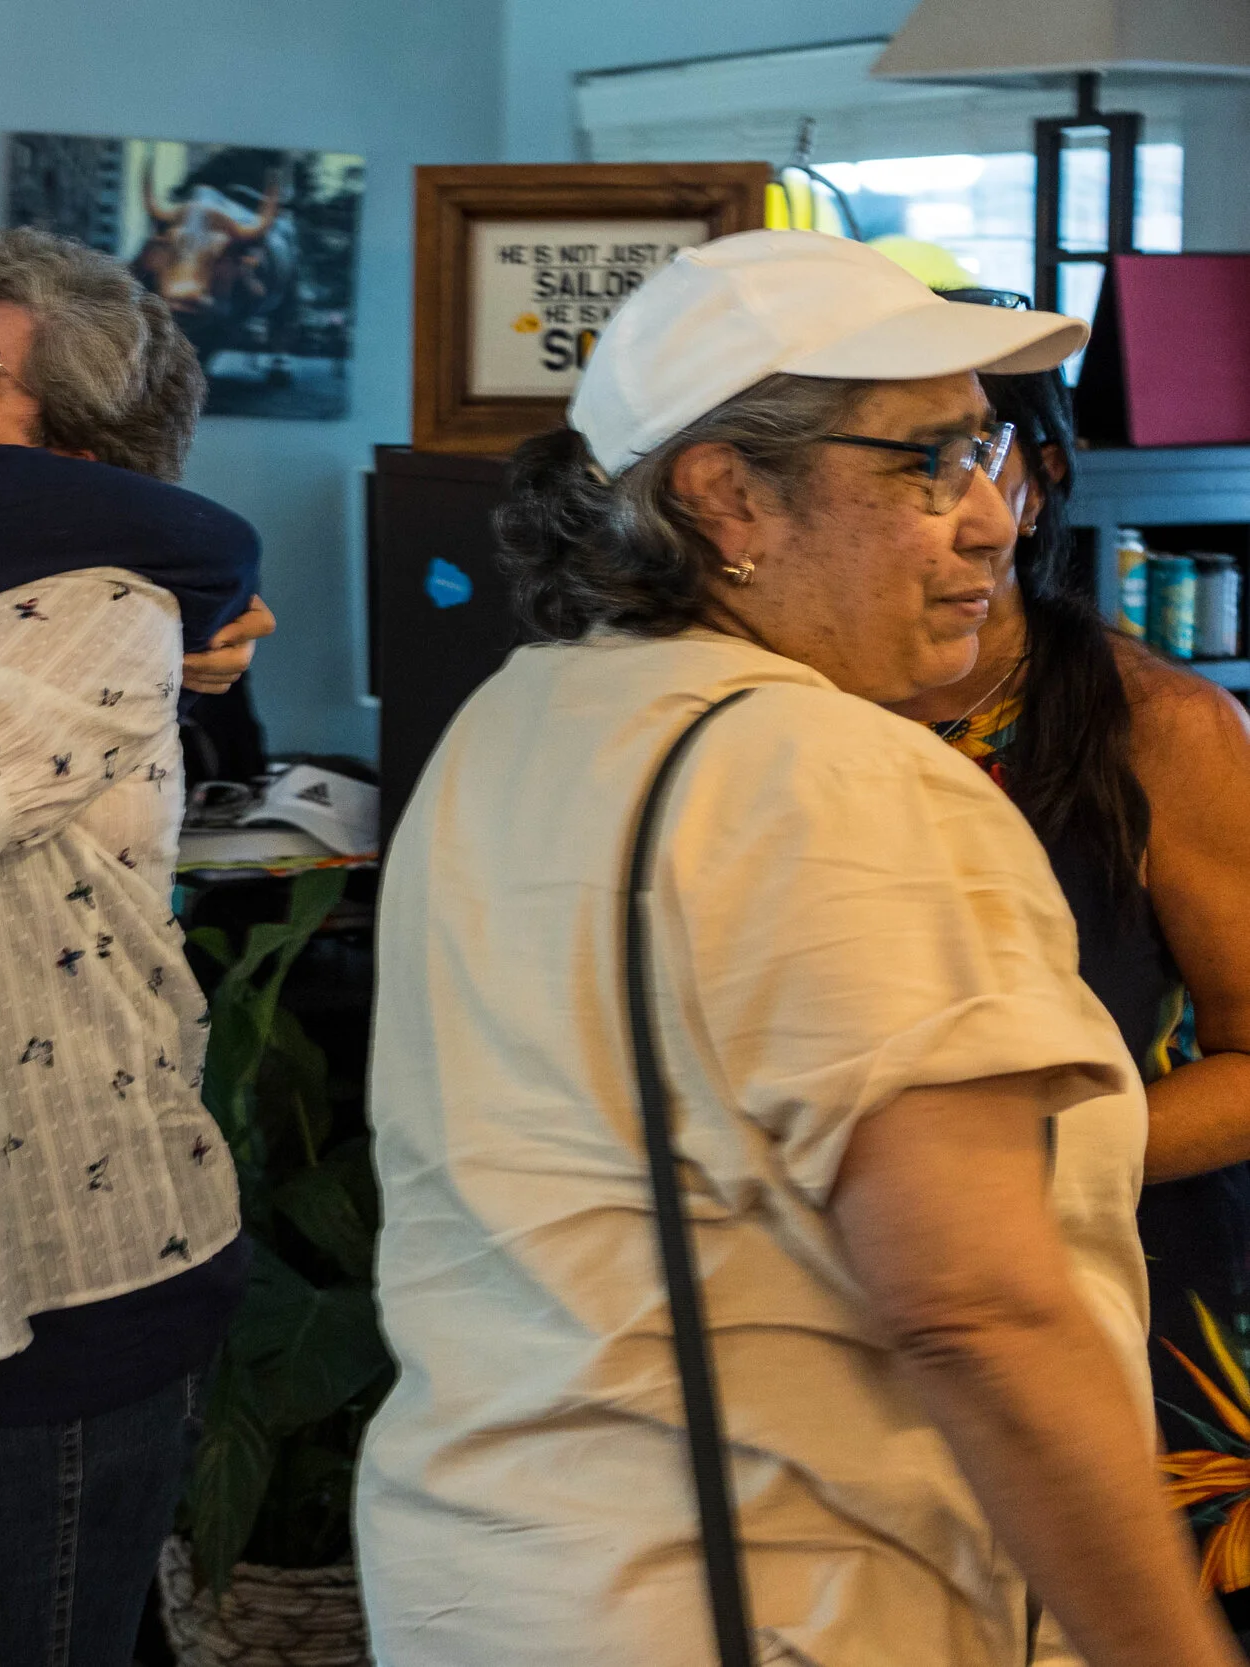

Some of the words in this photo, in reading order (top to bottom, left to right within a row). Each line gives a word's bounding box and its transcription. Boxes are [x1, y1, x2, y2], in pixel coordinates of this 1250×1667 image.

[499, 244, 526, 264] HE
[534, 244, 552, 264] IS
[559, 244, 599, 263] NOT
[603, 244, 658, 263] JUST
[544, 304, 572, 323] HE
[579, 304, 598, 323] IS
